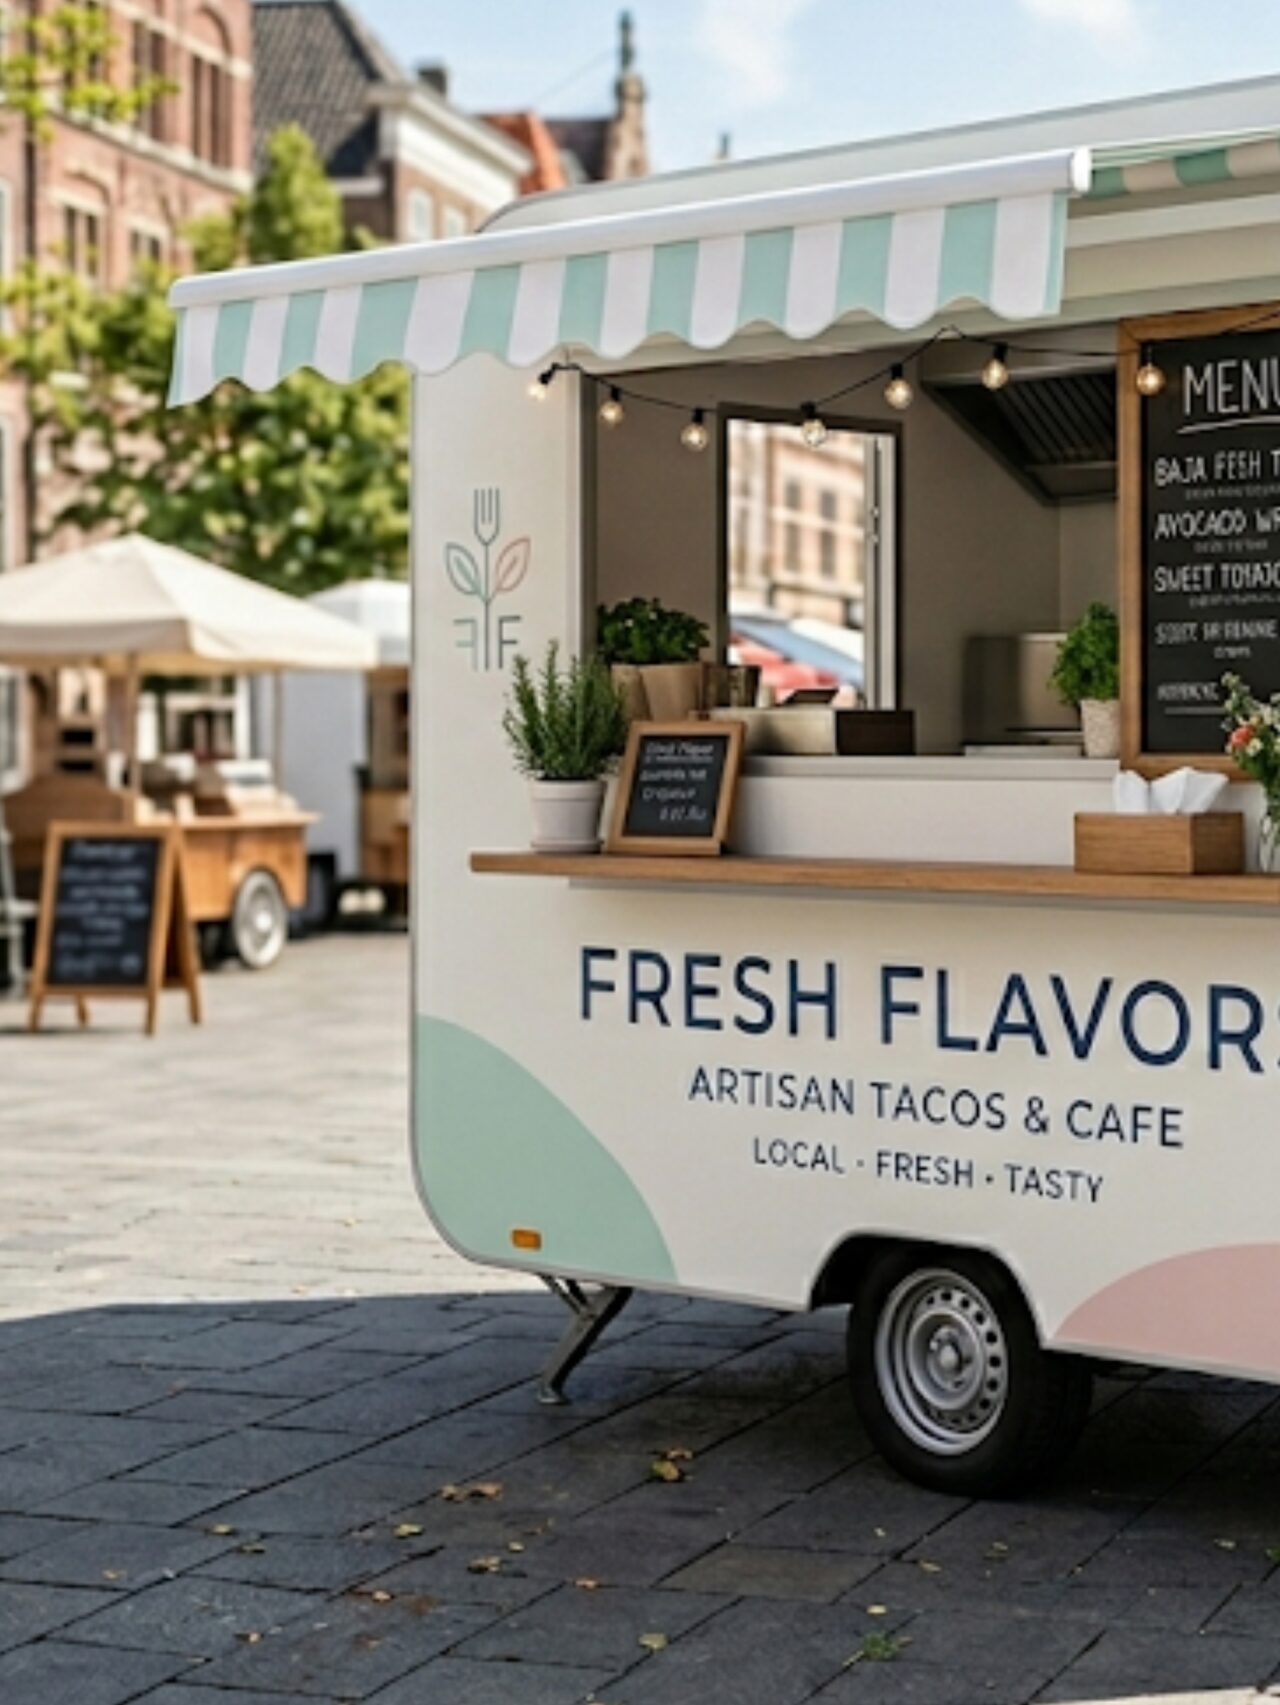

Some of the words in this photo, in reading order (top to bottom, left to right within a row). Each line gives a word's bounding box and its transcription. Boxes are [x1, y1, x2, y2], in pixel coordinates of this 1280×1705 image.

[580, 946, 837, 1040] FRESH
[688, 1066, 854, 1115] ARTISAN
[870, 1082, 1006, 1131] TACOS
[1023, 1096, 1050, 1134] &
[1066, 1099, 1184, 1148] CAFE
[754, 1137, 844, 1175] LOCAL
[876, 1150, 974, 1188] FRESH
[1004, 1163, 1104, 1203] TASTY
